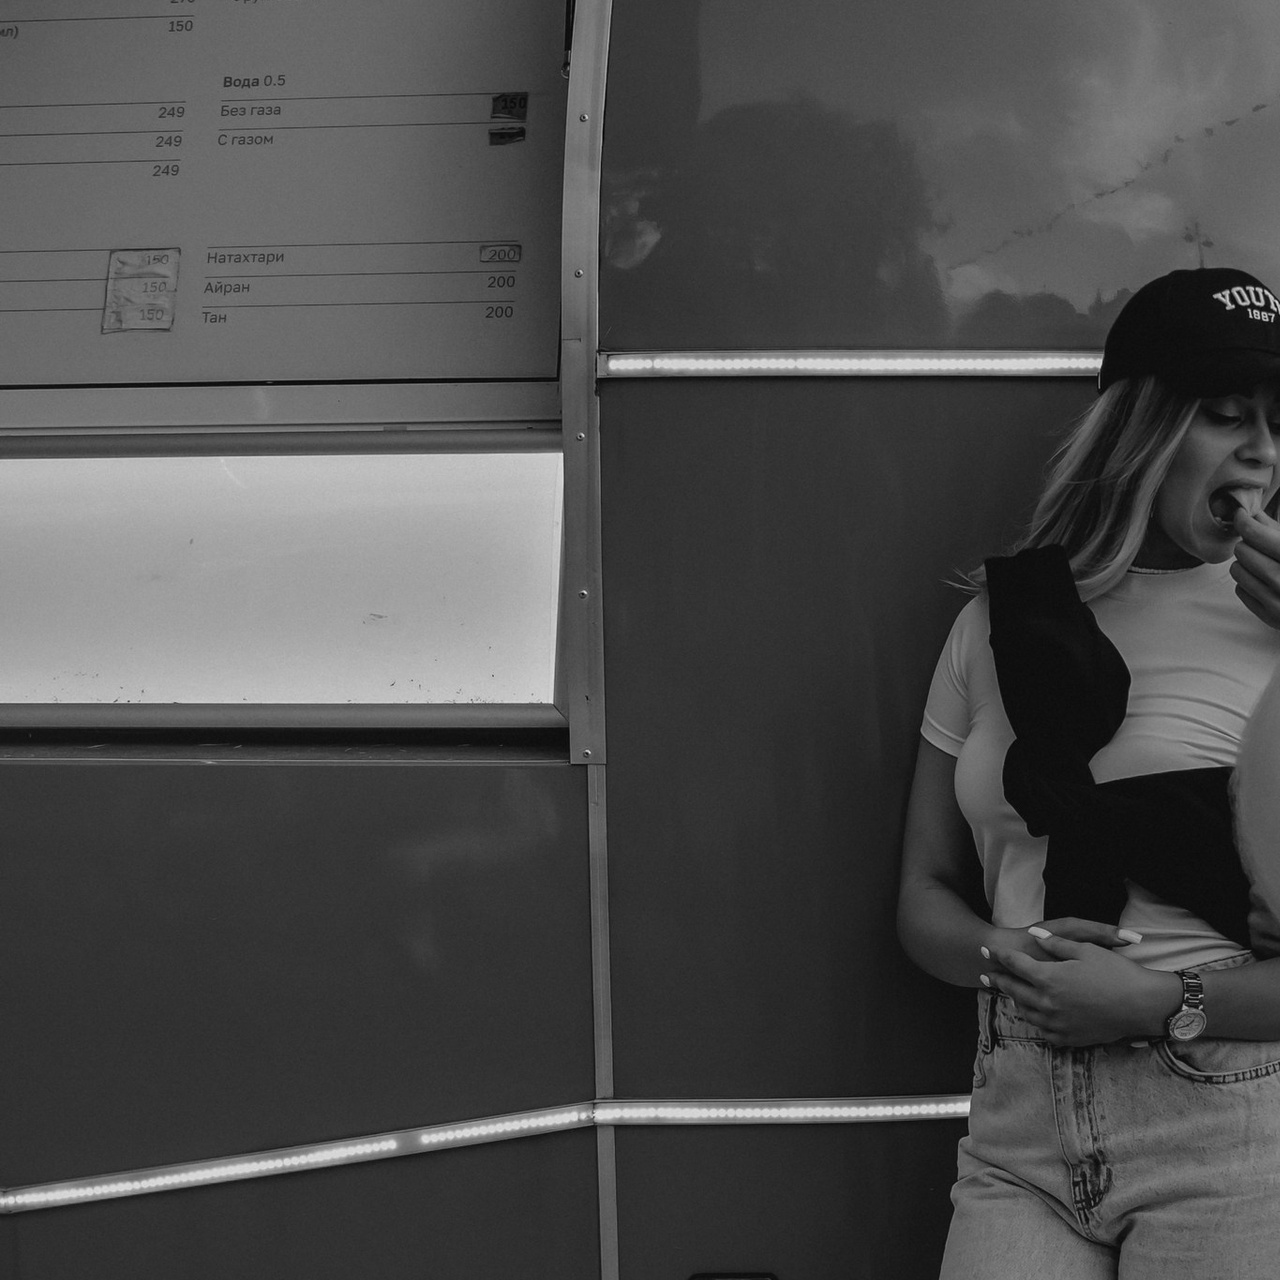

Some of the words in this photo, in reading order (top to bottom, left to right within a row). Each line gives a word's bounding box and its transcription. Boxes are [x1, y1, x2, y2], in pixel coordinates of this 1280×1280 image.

[168, 20, 193, 32] 150
[223, 76, 260, 89] Вода
[263, 74, 286, 87] 0.5
[158, 106, 185, 119] 249
[220, 105, 246, 117] Без
[250, 106, 281, 116] газа
[155, 135, 183, 148] 249
[217, 134, 228, 146] С
[231, 135, 274, 145] газом
[152, 164, 180, 177] 249
[146, 254, 170, 265] 150
[207, 252, 285, 266] Натахтари
[488, 248, 516, 261] 200
[142, 281, 167, 293] 150
[487, 275, 516, 288] 200
[204, 282, 250, 296] Айран
[139, 309, 164, 321] 150
[202, 311, 227, 324] Тан
[485, 305, 514, 319] 200
[1246, 307, 1276, 323] 1887
